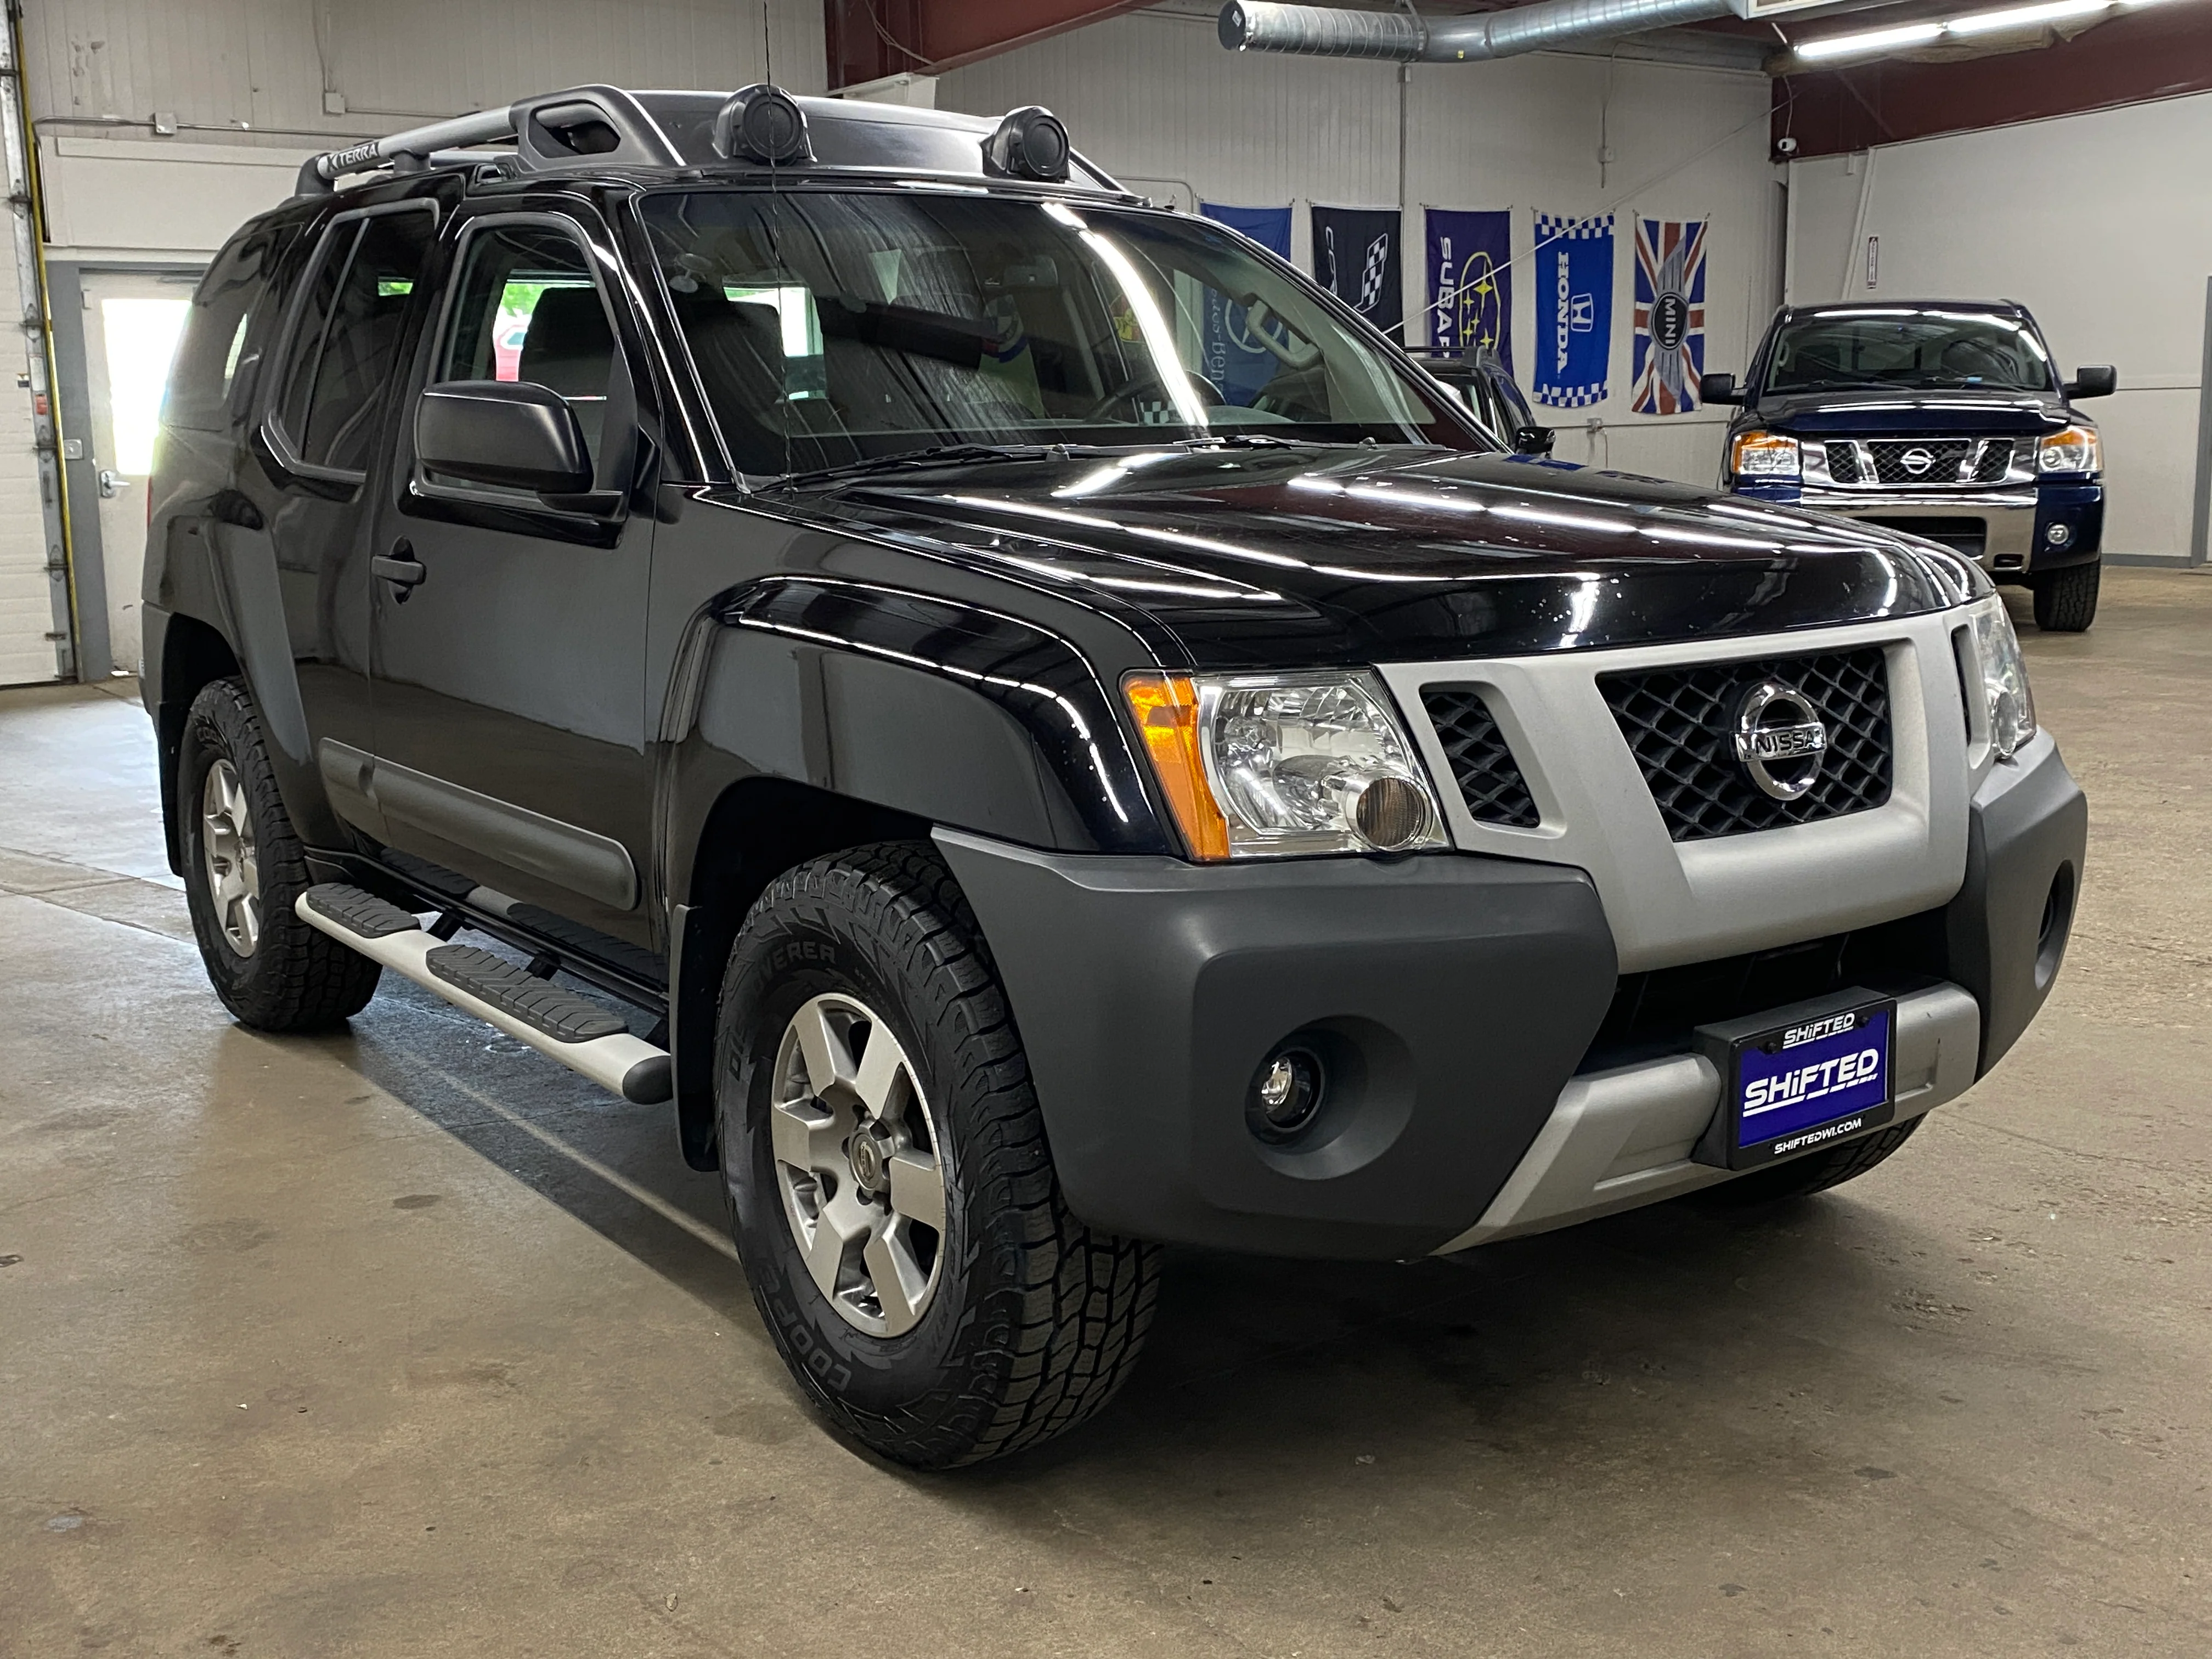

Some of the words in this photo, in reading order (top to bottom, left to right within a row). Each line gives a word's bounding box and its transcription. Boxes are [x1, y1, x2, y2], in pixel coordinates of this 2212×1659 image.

[326, 143, 379, 172] XTERRA
[1558, 251, 1570, 374] HONDA
[1665, 298, 1677, 344] MINI
[1774, 1118, 1861, 1154] SHIFTEDWI.COM
